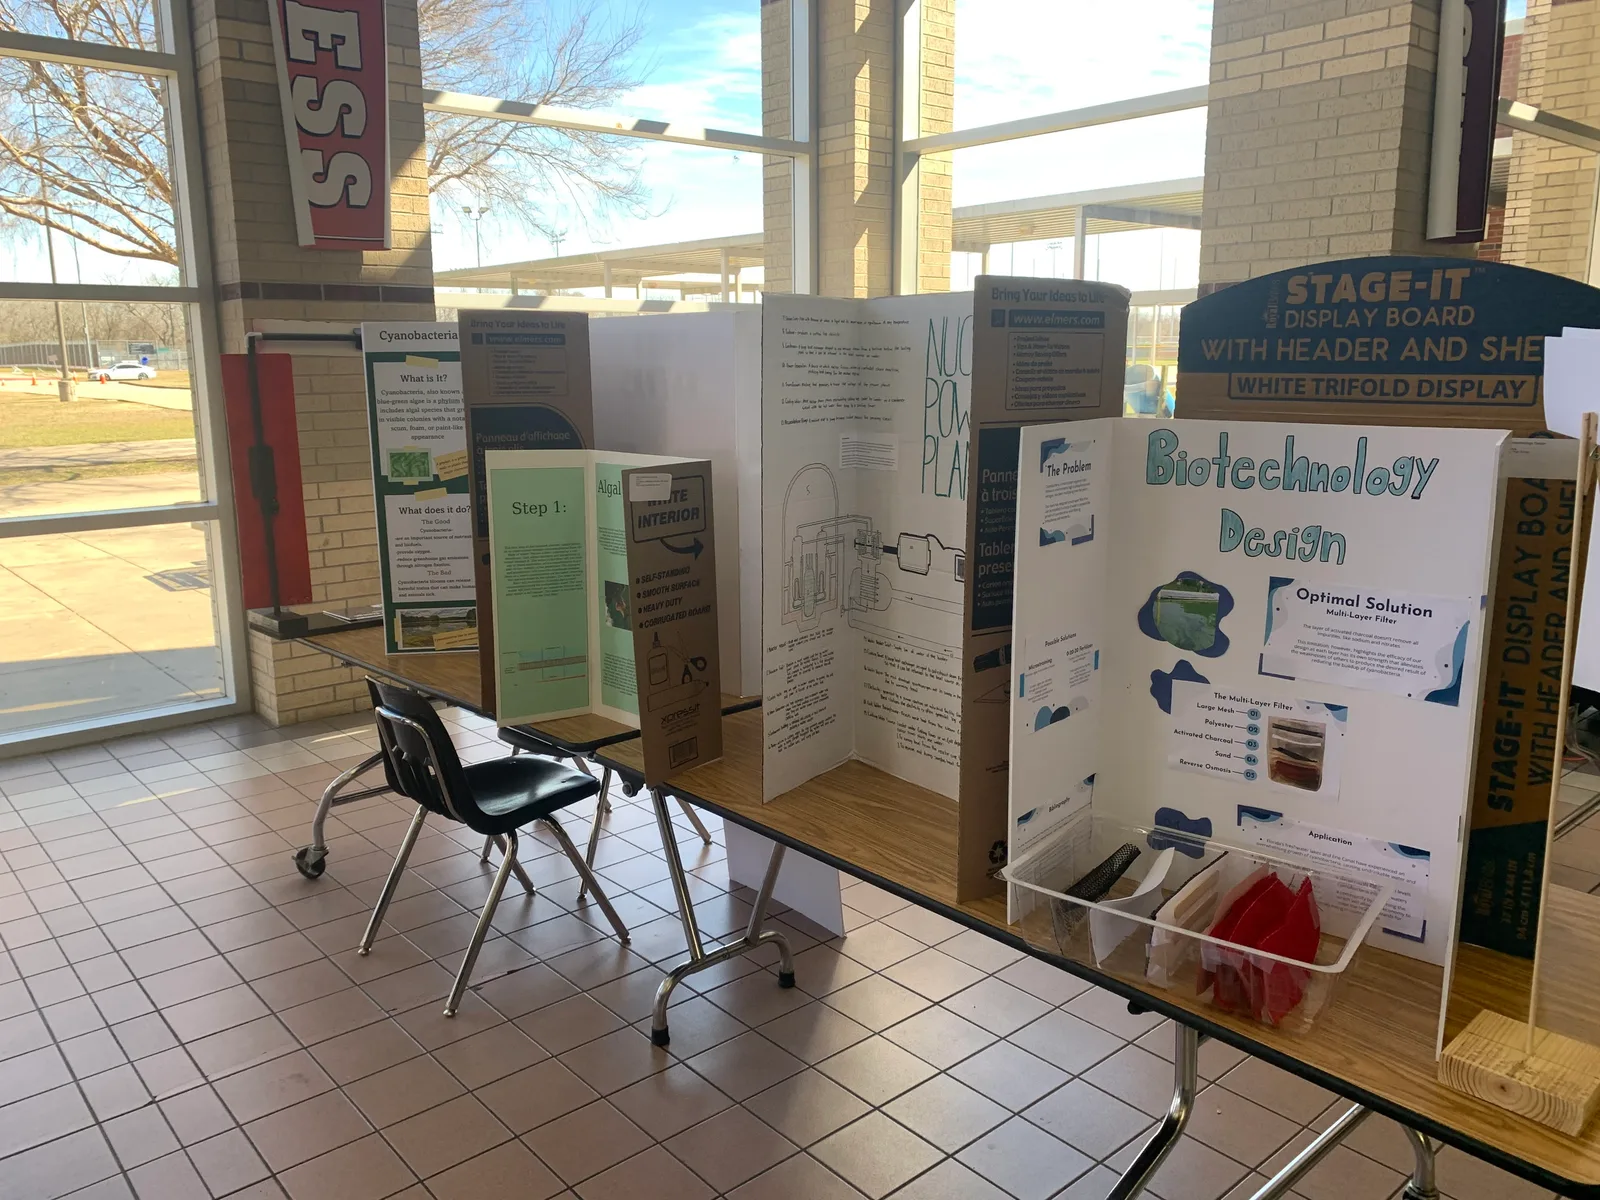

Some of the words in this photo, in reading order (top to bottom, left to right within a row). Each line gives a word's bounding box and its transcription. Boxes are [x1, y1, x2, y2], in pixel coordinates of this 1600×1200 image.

[1287, 267, 1470, 305] STAGE-IT
[992, 287, 1020, 302] Bring
[1022, 289, 1048, 302] Your
[1050, 290, 1076, 302] Ideas
[1078, 291, 1087, 302] to
[471, 319, 493, 329] Bring
[496, 320, 515, 328] Your
[551, 321, 565, 329] Life
[1014, 312, 1100, 325] www.elmers.com
[1285, 308, 1378, 329] DISPLAY
[1386, 305, 1475, 328] BOARD
[380, 330, 458, 342] Cyanobacteria
[1201, 338, 1267, 362] WITH
[1277, 337, 1389, 362] HEADER
[1400, 336, 1467, 362] AND
[1480, 335, 1545, 362] SHE
[436, 374, 447, 382] It?
[1237, 377, 1306, 395] WHITE
[1312, 377, 1409, 398] TRIFOLD
[1417, 379, 1527, 400] DISPLAY
[476, 433, 518, 442] Panneau
[520, 431, 570, 440] d'affichage
[1047, 464, 1060, 477] The
[1063, 460, 1091, 474] Problem
[1146, 429, 1439, 499] Biotechnology
[982, 468, 1018, 484] Panne
[598, 480, 621, 497] Algal
[981, 488, 989, 502] à
[648, 489, 688, 507] ITE
[425, 506, 445, 514] does
[512, 501, 547, 516] Step
[553, 500, 567, 513] 1:
[638, 507, 699, 529] INTERIOR
[1219, 508, 1346, 565] Design
[979, 542, 1015, 557] Tabler
[641, 566, 690, 584] SELF-STANDING
[978, 562, 1014, 578] prese
[642, 585, 669, 599] SMOOTH
[671, 579, 700, 593] SURFACE
[643, 600, 664, 613] HEAVY
[666, 597, 683, 608] DUTY
[1296, 588, 1360, 607] Optimal
[1366, 597, 1433, 618] Solution
[1503, 546, 1542, 665] DISPLAY
[644, 612, 687, 629] CORRUGATED
[688, 605, 710, 617] BOARD
[1326, 609, 1372, 622] Multi-Layer
[1375, 614, 1397, 625] Filter
[1045, 637, 1060, 647] Possible
[1060, 632, 1076, 642] Solutions
[1330, 628, 1352, 636] activated
[1353, 631, 1373, 639] charcoal
[1352, 636, 1370, 644] sodium
[1353, 647, 1376, 656] highlights
[1197, 703, 1216, 712] Large
[1217, 706, 1234, 714] Mesh
[1214, 692, 1227, 701] The
[1229, 695, 1271, 708] Multi-Layer
[1273, 702, 1293, 711] Filter
[1205, 719, 1234, 729] Polyester
[1174, 728, 1203, 740] Activated
[1205, 734, 1233, 745] Charcoal
[1487, 680, 1527, 812] STAGE-IT
[1527, 720, 1556, 786] WITH
[1215, 750, 1231, 759] Sand
[1179, 759, 1203, 769] Reverse
[1205, 765, 1231, 774] Osmosis
[1308, 830, 1352, 846] Application
[1310, 847, 1321, 855] lakes
[1342, 855, 1355, 863] Canal
[1356, 858, 1368, 866] have
[1368, 861, 1398, 874] experienced
